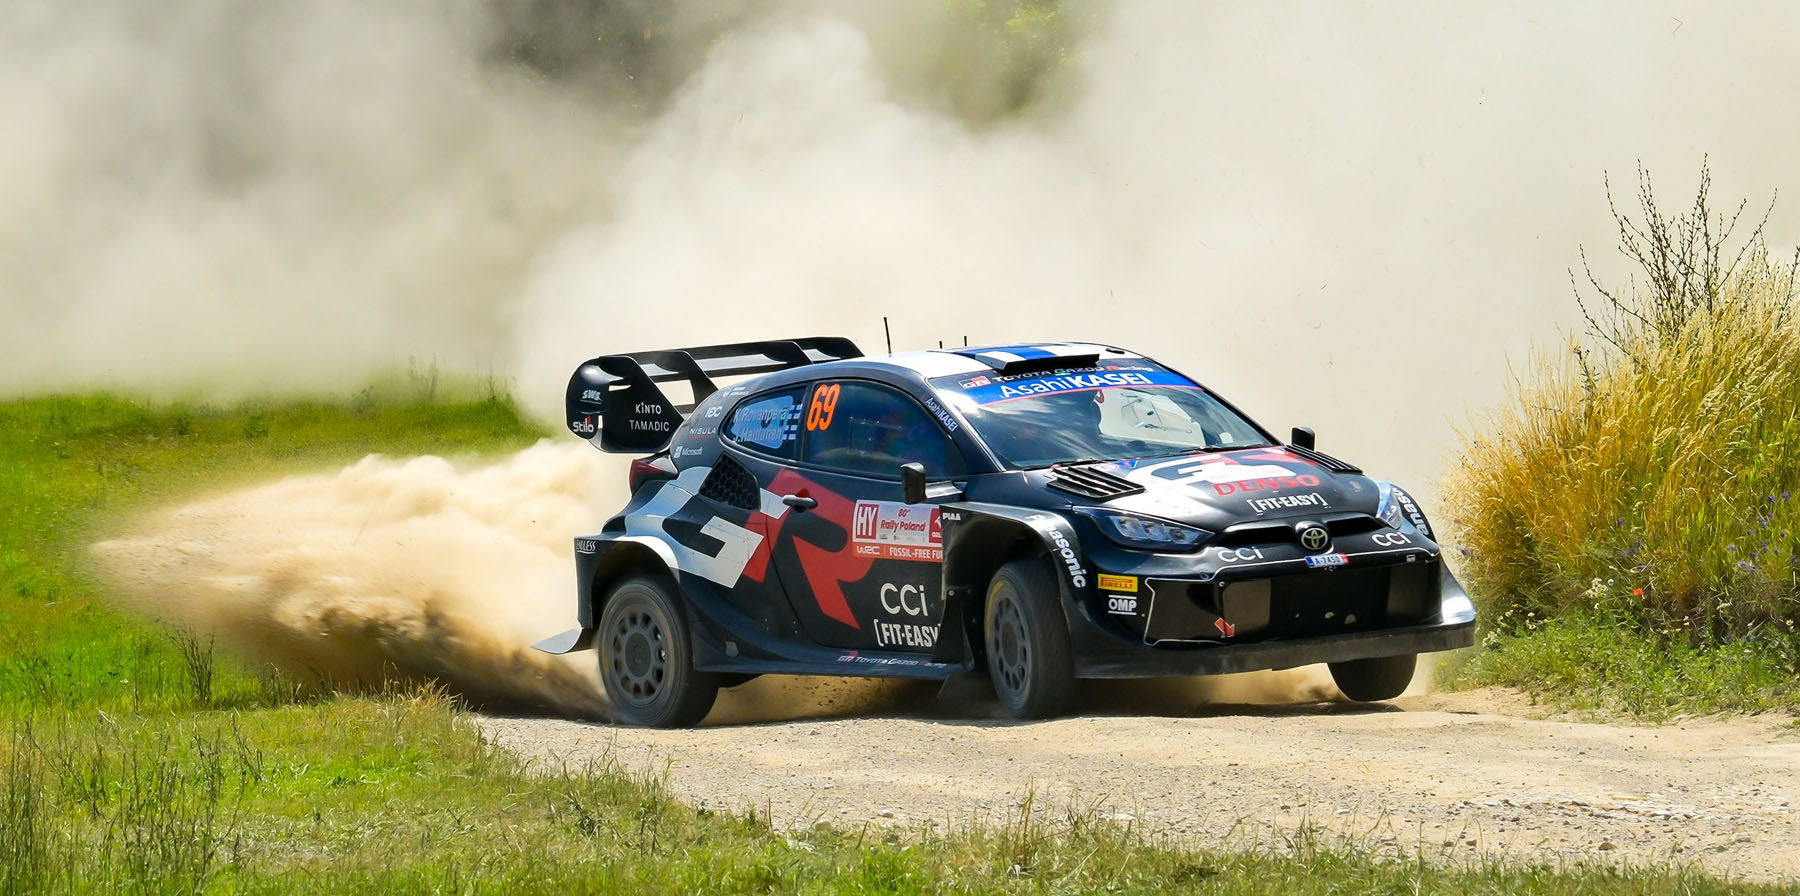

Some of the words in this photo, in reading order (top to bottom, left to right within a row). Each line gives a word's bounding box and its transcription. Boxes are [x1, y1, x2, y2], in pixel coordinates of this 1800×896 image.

[1002, 373, 1153, 398] AsahiKASEI
[807, 384, 841, 431] 69
[925, 397, 959, 432] AsahiKASEI
[572, 414, 595, 433] Stilo
[629, 420, 670, 432] TAMADIC
[690, 427, 716, 435] NISULA
[1212, 474, 1320, 496] DENSO
[857, 506, 878, 536] HY
[880, 519, 900, 533] Rally
[899, 521, 926, 532] Poland
[942, 512, 961, 521] PIAA
[889, 547, 931, 559] FOSSIL-FREE
[932, 549, 943, 559] FU
[1025, 513, 1087, 588] Pasonic
[1108, 598, 1137, 612] OMP
[873, 619, 942, 647] [FIT-EASY
